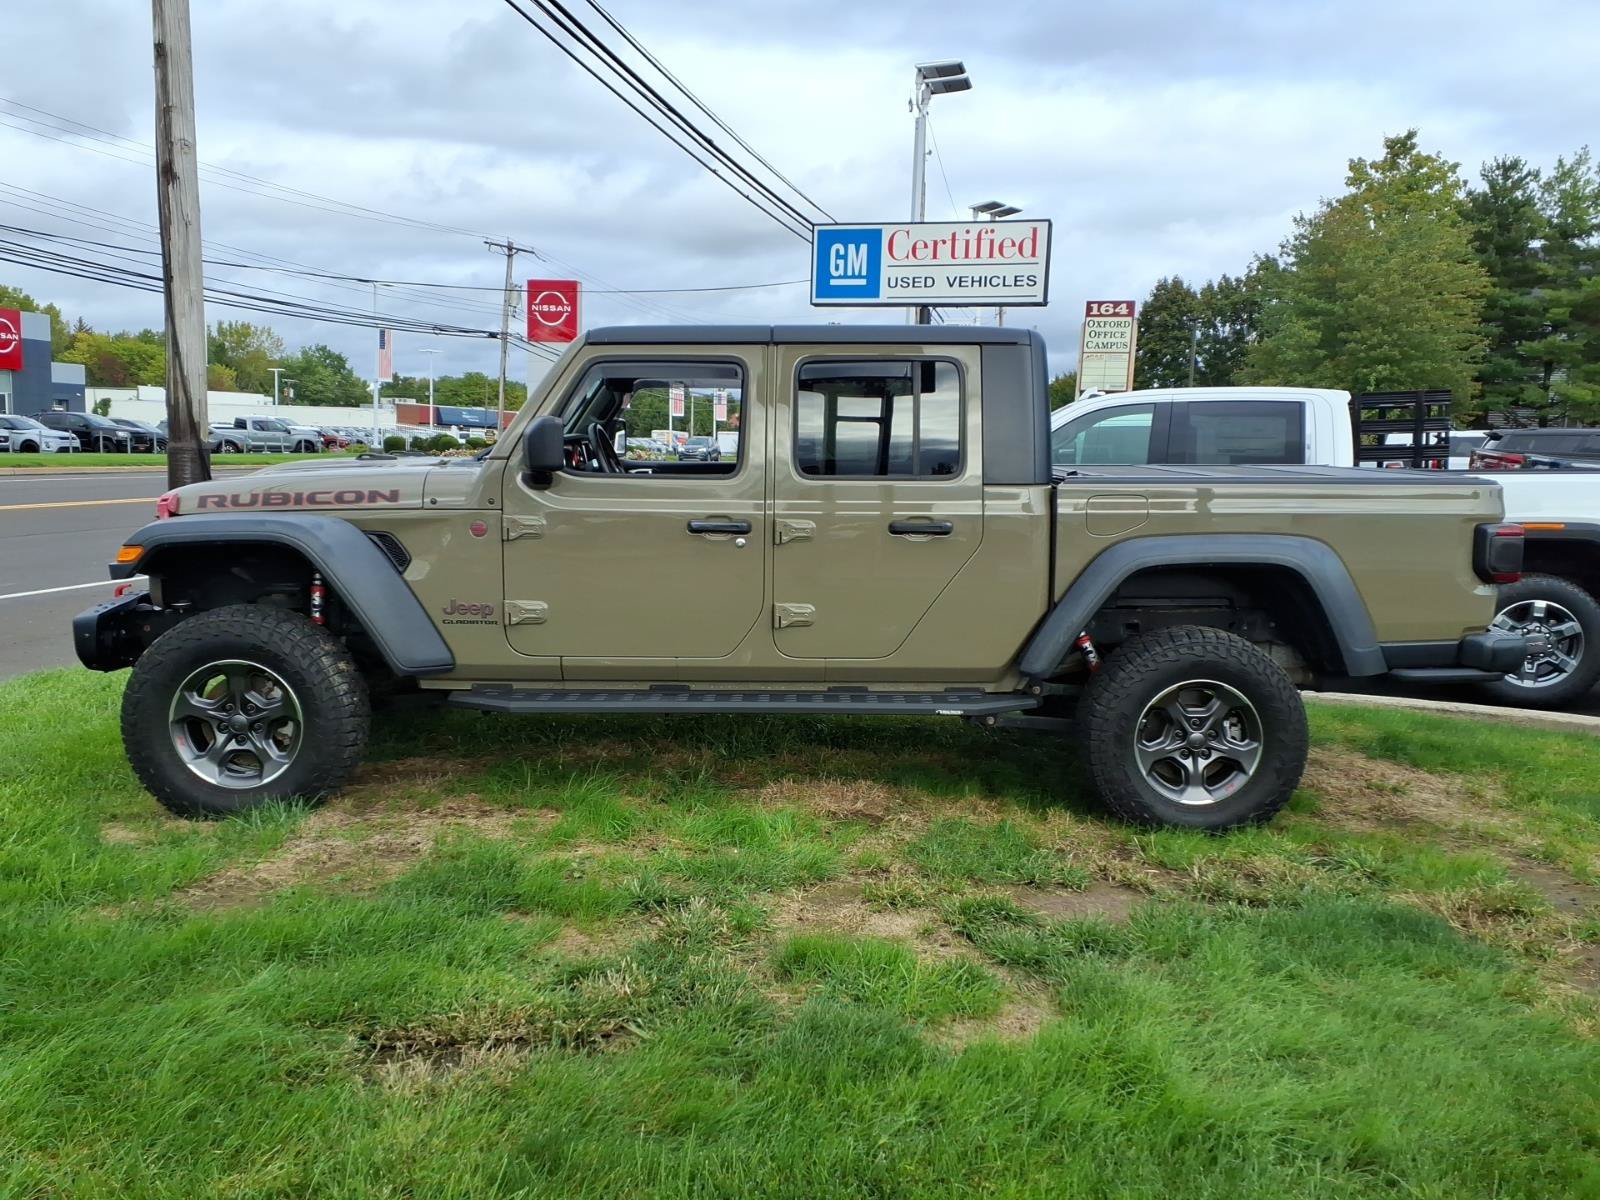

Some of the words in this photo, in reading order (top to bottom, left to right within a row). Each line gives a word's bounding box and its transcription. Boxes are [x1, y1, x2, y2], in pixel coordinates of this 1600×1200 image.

[887, 226, 1038, 261] Certified
[829, 243, 868, 277] GM
[887, 276, 936, 289] USED
[946, 274, 1038, 288] VEHICLES
[531, 304, 571, 312] NISSAN
[1089, 303, 1129, 315] 164
[1087, 319, 1130, 329] OXFORD
[1088, 329, 1127, 339] OFFICE
[1086, 340, 1129, 350] CAMPUS
[197, 489, 400, 509] RUBICON
[443, 598, 495, 619] Jeep
